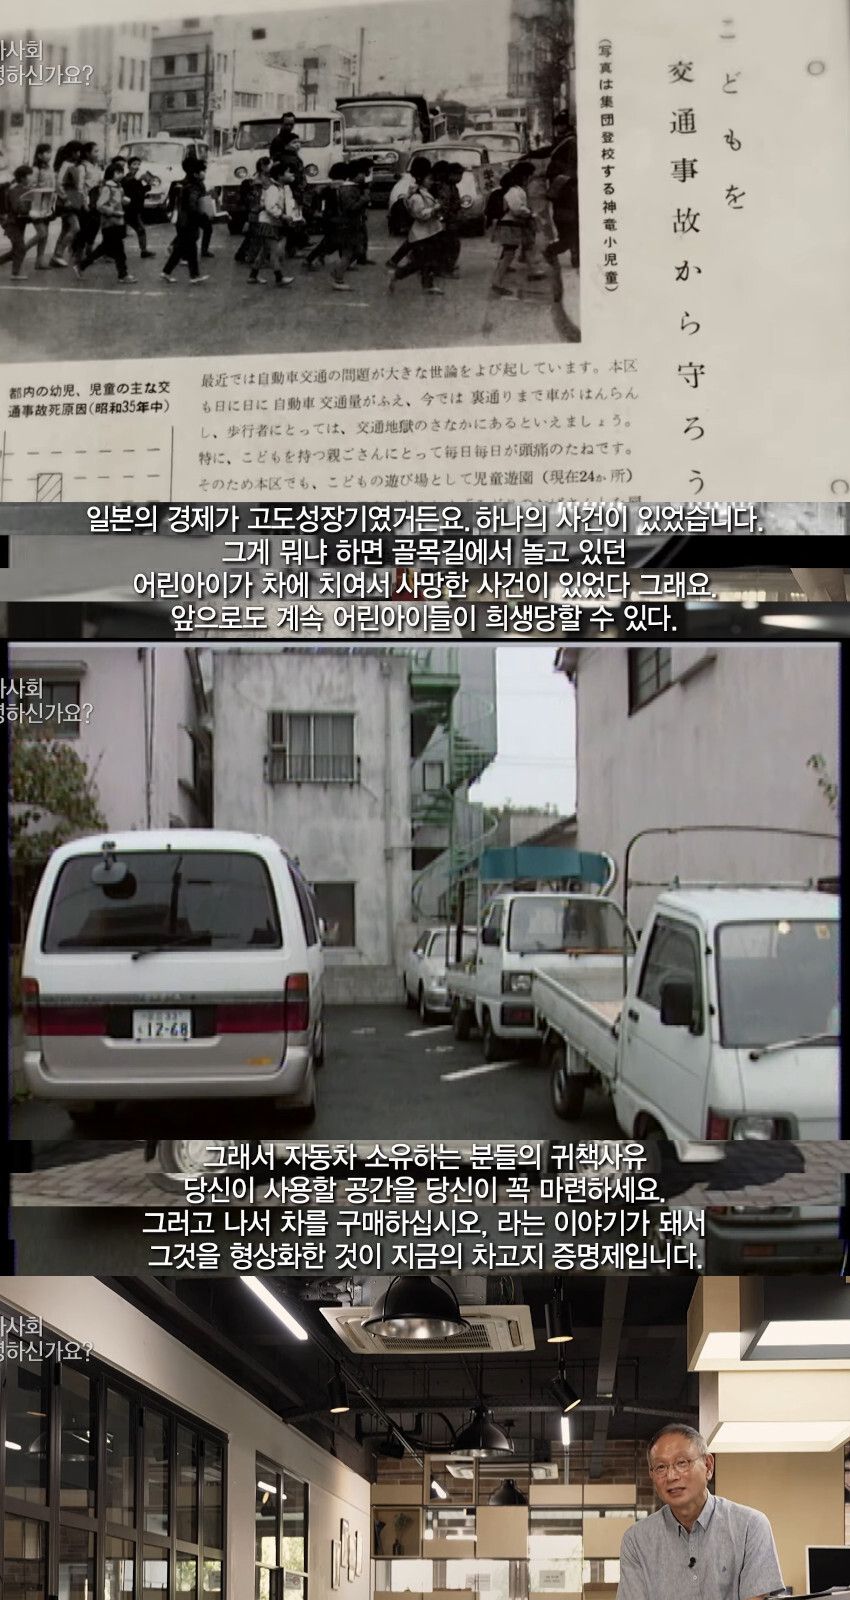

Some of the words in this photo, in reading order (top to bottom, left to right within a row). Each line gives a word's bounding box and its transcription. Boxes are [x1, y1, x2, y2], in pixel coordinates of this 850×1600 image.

[667, 60, 706, 495] 交通事故から守ろう
